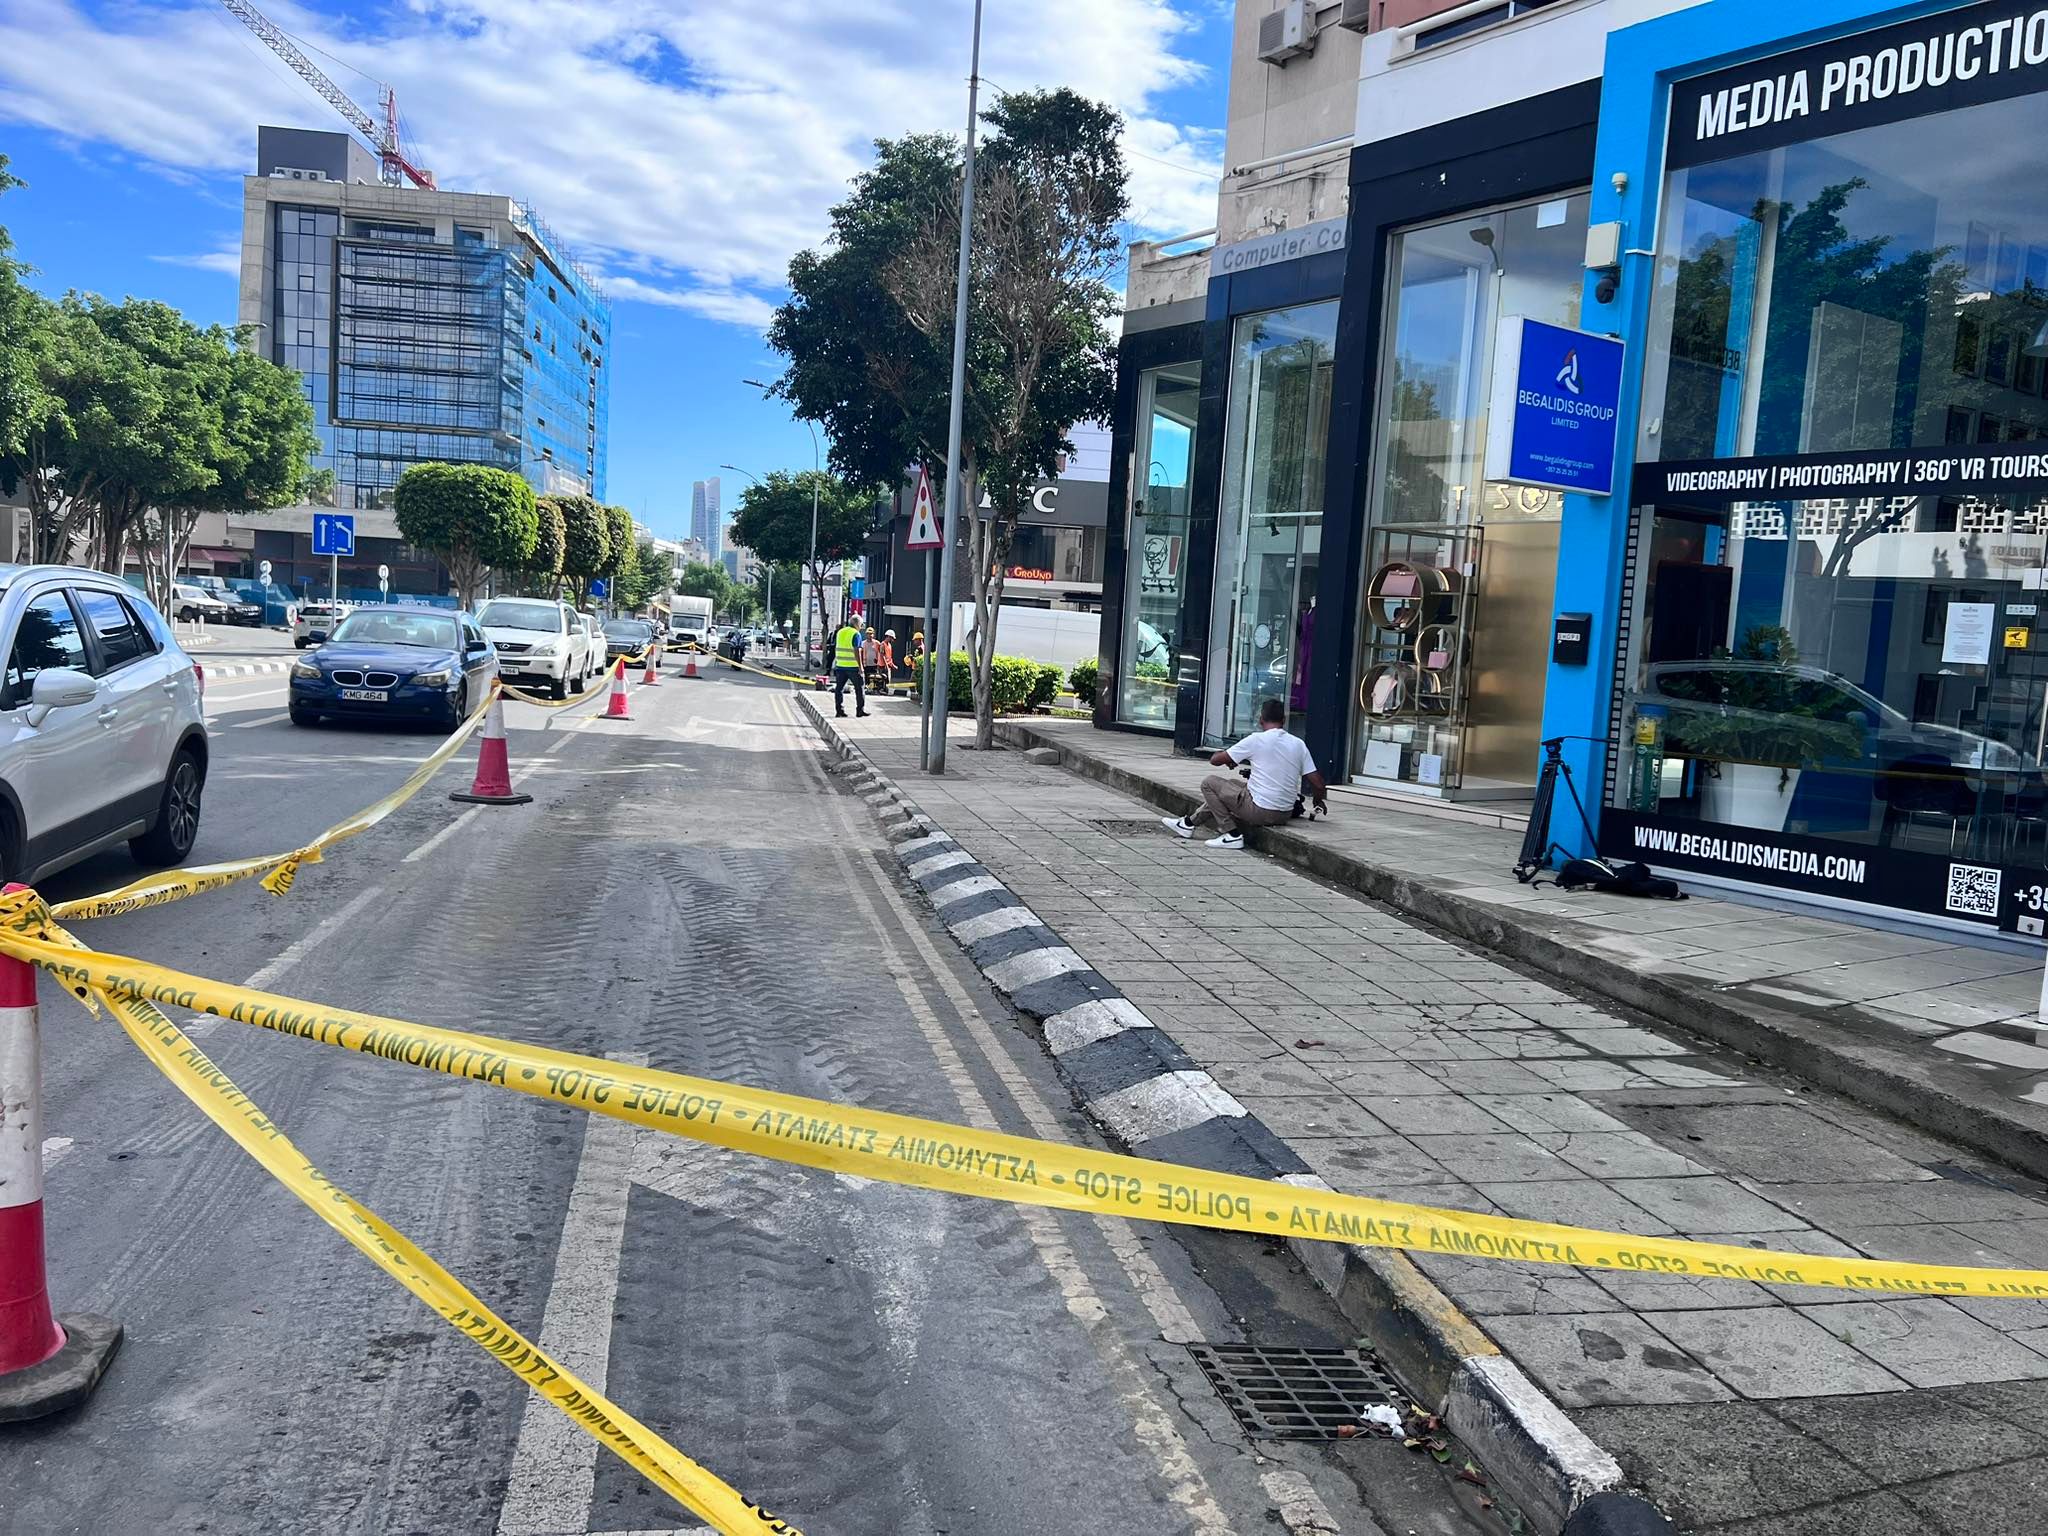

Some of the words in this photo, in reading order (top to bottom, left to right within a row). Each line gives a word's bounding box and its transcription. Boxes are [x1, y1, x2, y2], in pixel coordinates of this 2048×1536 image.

[1696, 69, 1809, 141] MEDIA
[1820, 10, 2048, 112] PRODUCTIO
[1223, 236, 1306, 269] Computer
[1551, 416, 1579, 430] LIMITED
[1667, 468, 1767, 492] VIDEOGRAPHY
[1779, 461, 1901, 487] PHOTOGRAPHY
[1990, 454, 2048, 478] TOURS
[344, 690, 361, 700] KMG
[363, 691, 382, 700] 464
[1634, 826, 1866, 883] WWW.BEGALIDISMEDIA.COM
